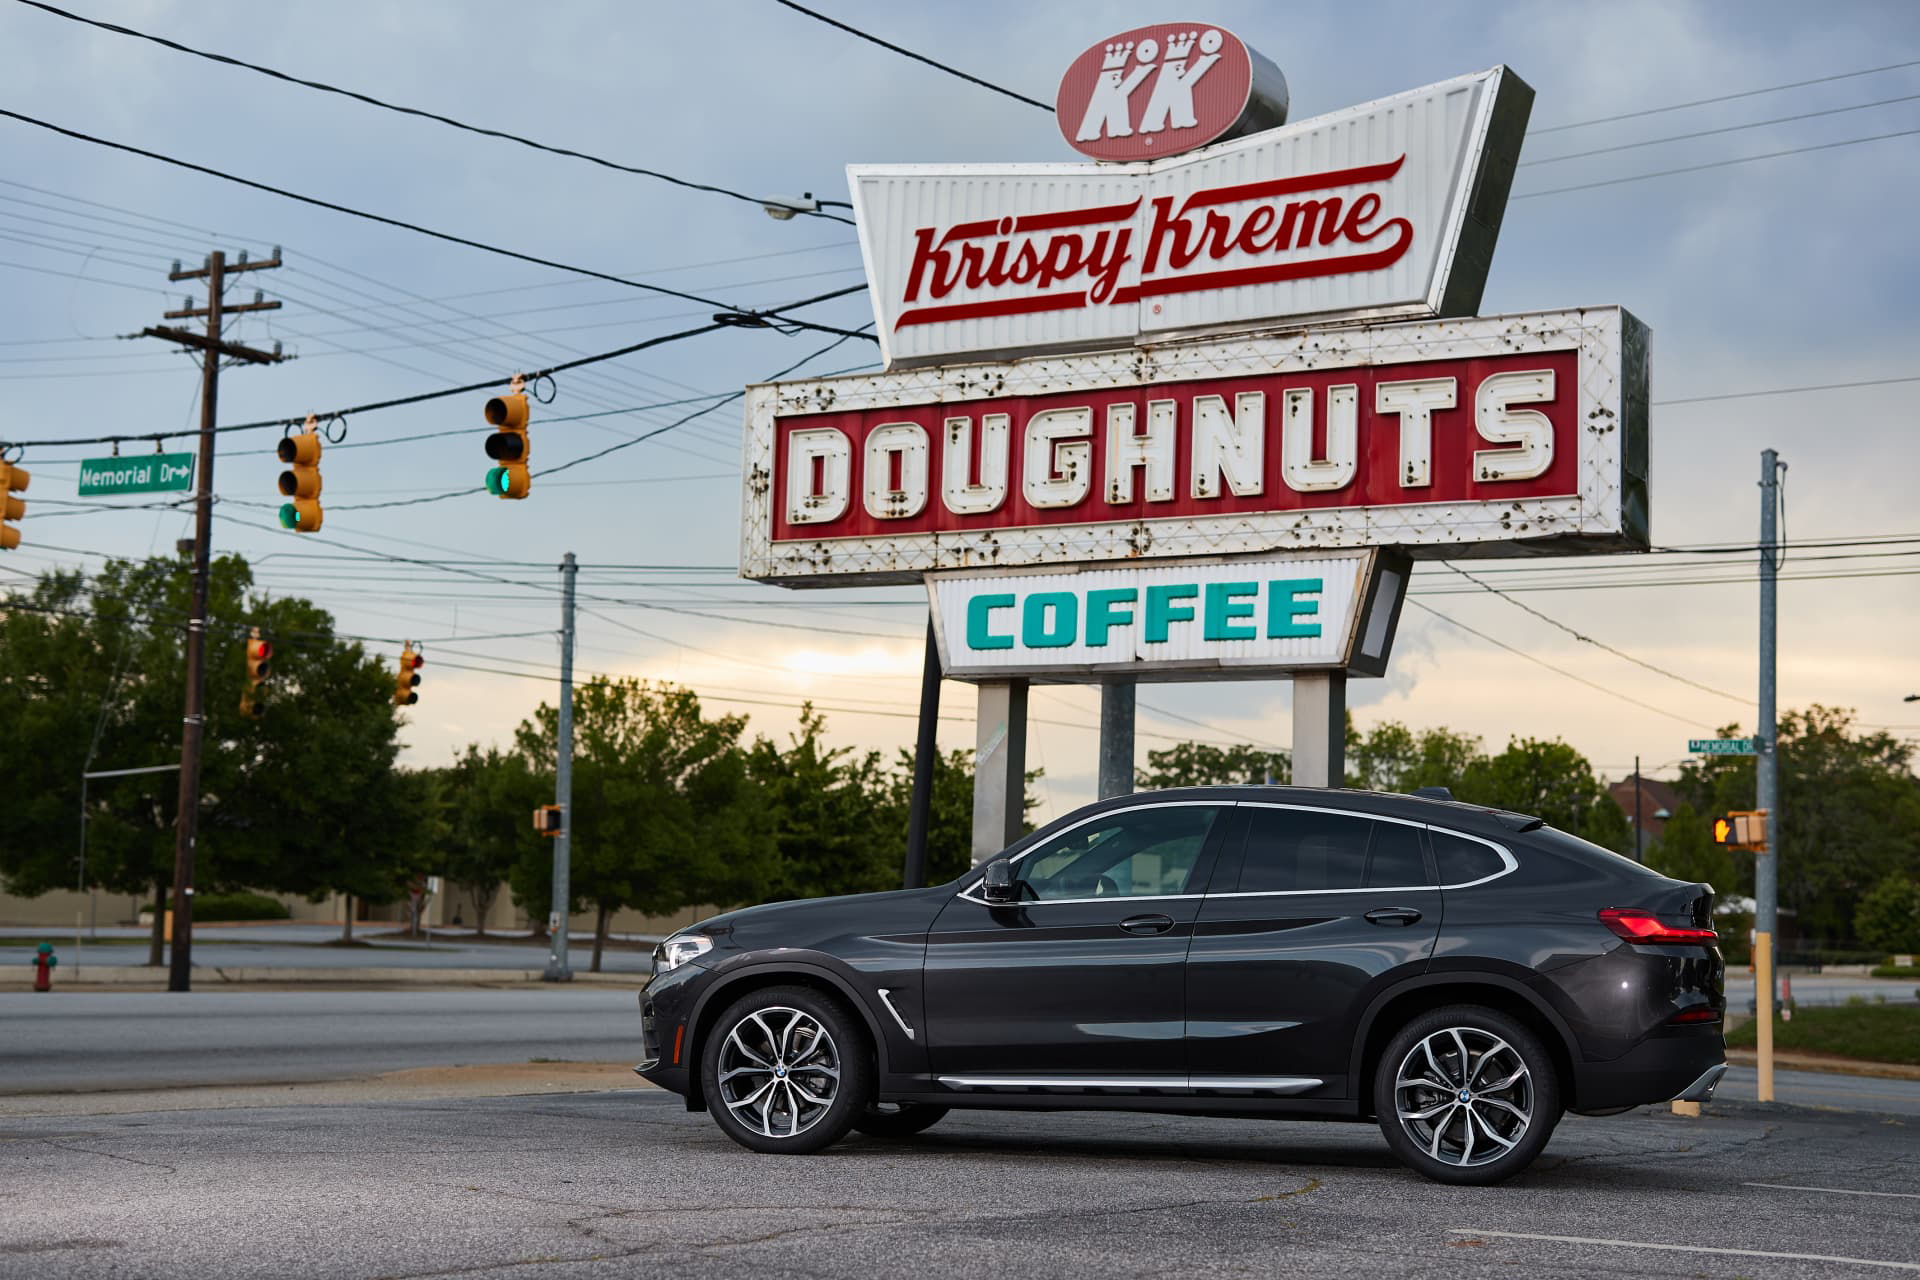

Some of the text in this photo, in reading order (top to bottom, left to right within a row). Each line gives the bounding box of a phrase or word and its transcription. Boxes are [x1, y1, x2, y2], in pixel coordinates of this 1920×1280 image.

[1076, 50, 1222, 142] KK
[903, 154, 1412, 304] Krispy Kreme
[81, 463, 176, 487] Memorial Dr
[786, 368, 1556, 526] DOUGHNUTS
[966, 577, 1323, 651] COFFEE
[1701, 741, 1741, 752] MEMORIAL
